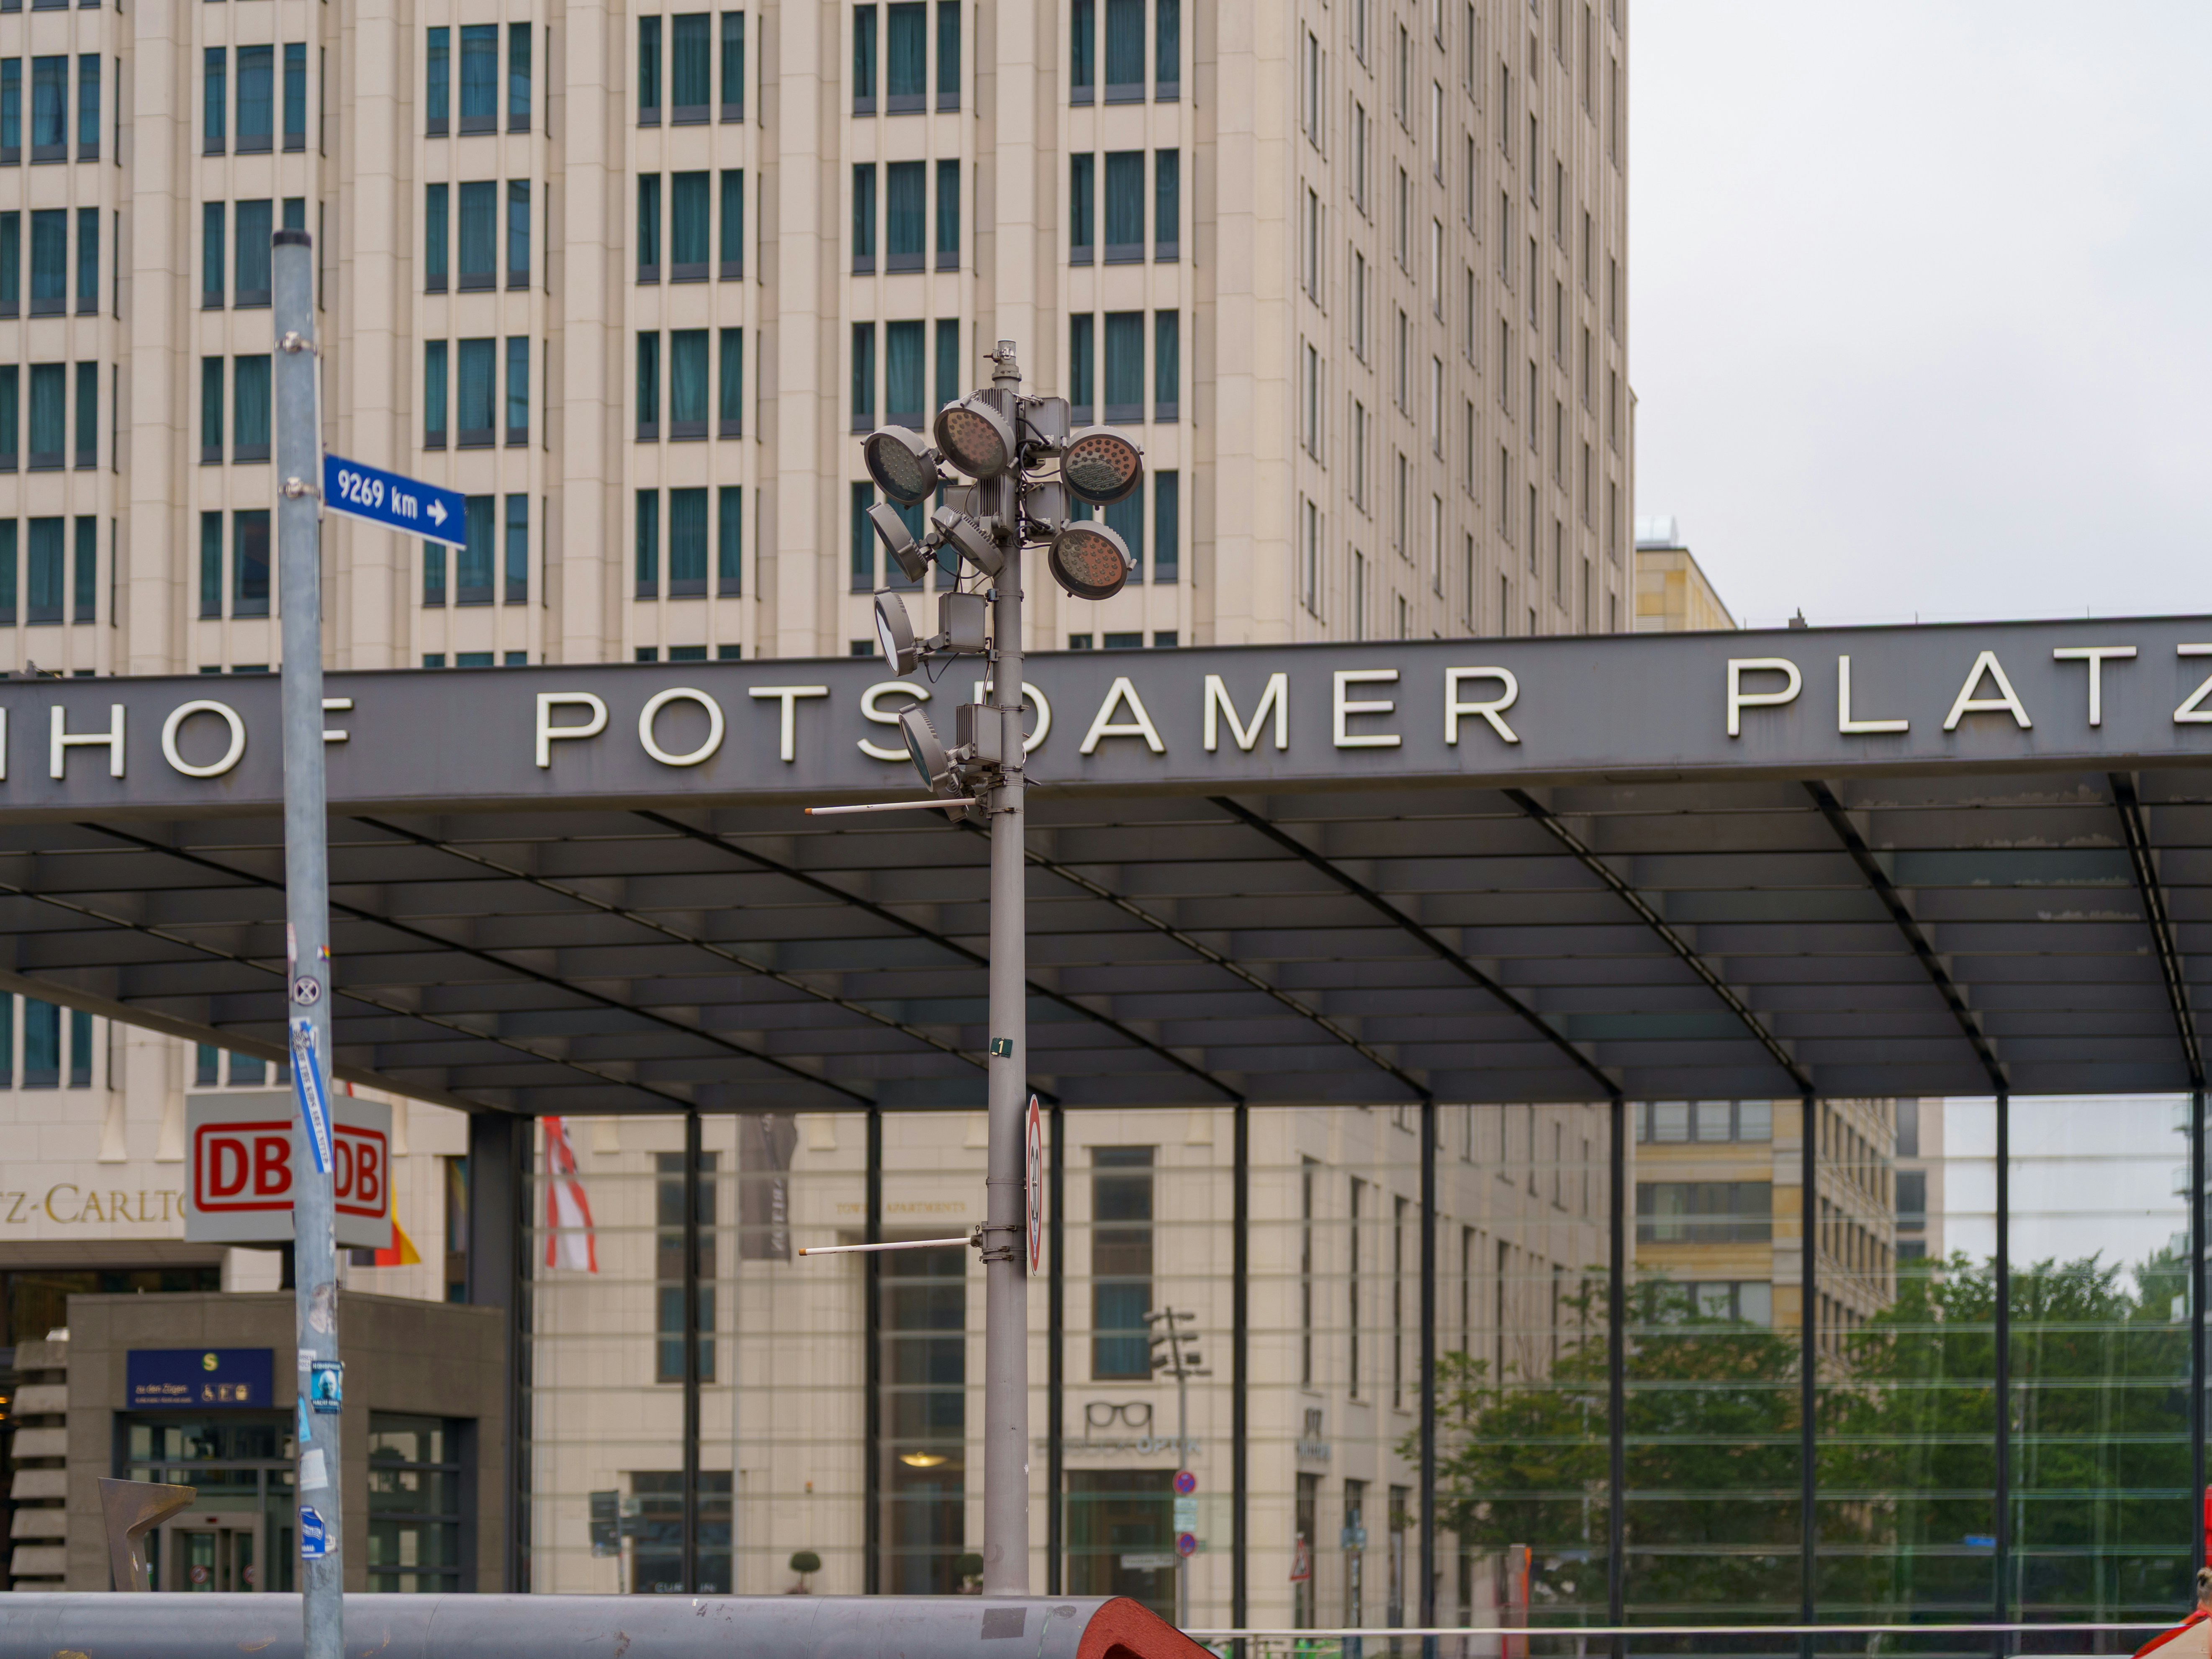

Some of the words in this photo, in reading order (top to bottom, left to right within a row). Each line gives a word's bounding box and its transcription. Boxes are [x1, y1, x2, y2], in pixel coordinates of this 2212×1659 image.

[338, 469, 384, 509] 9269
[391, 485, 418, 520] km
[536, 666, 1520, 768] POTSDAMER
[209, 1136, 292, 1197] DB
[334, 1140, 378, 1201] DB
[1030, 1145, 1039, 1224] 30
[886, 1201, 966, 1213] APARTMENTS
[203, 1353, 218, 1371] S
